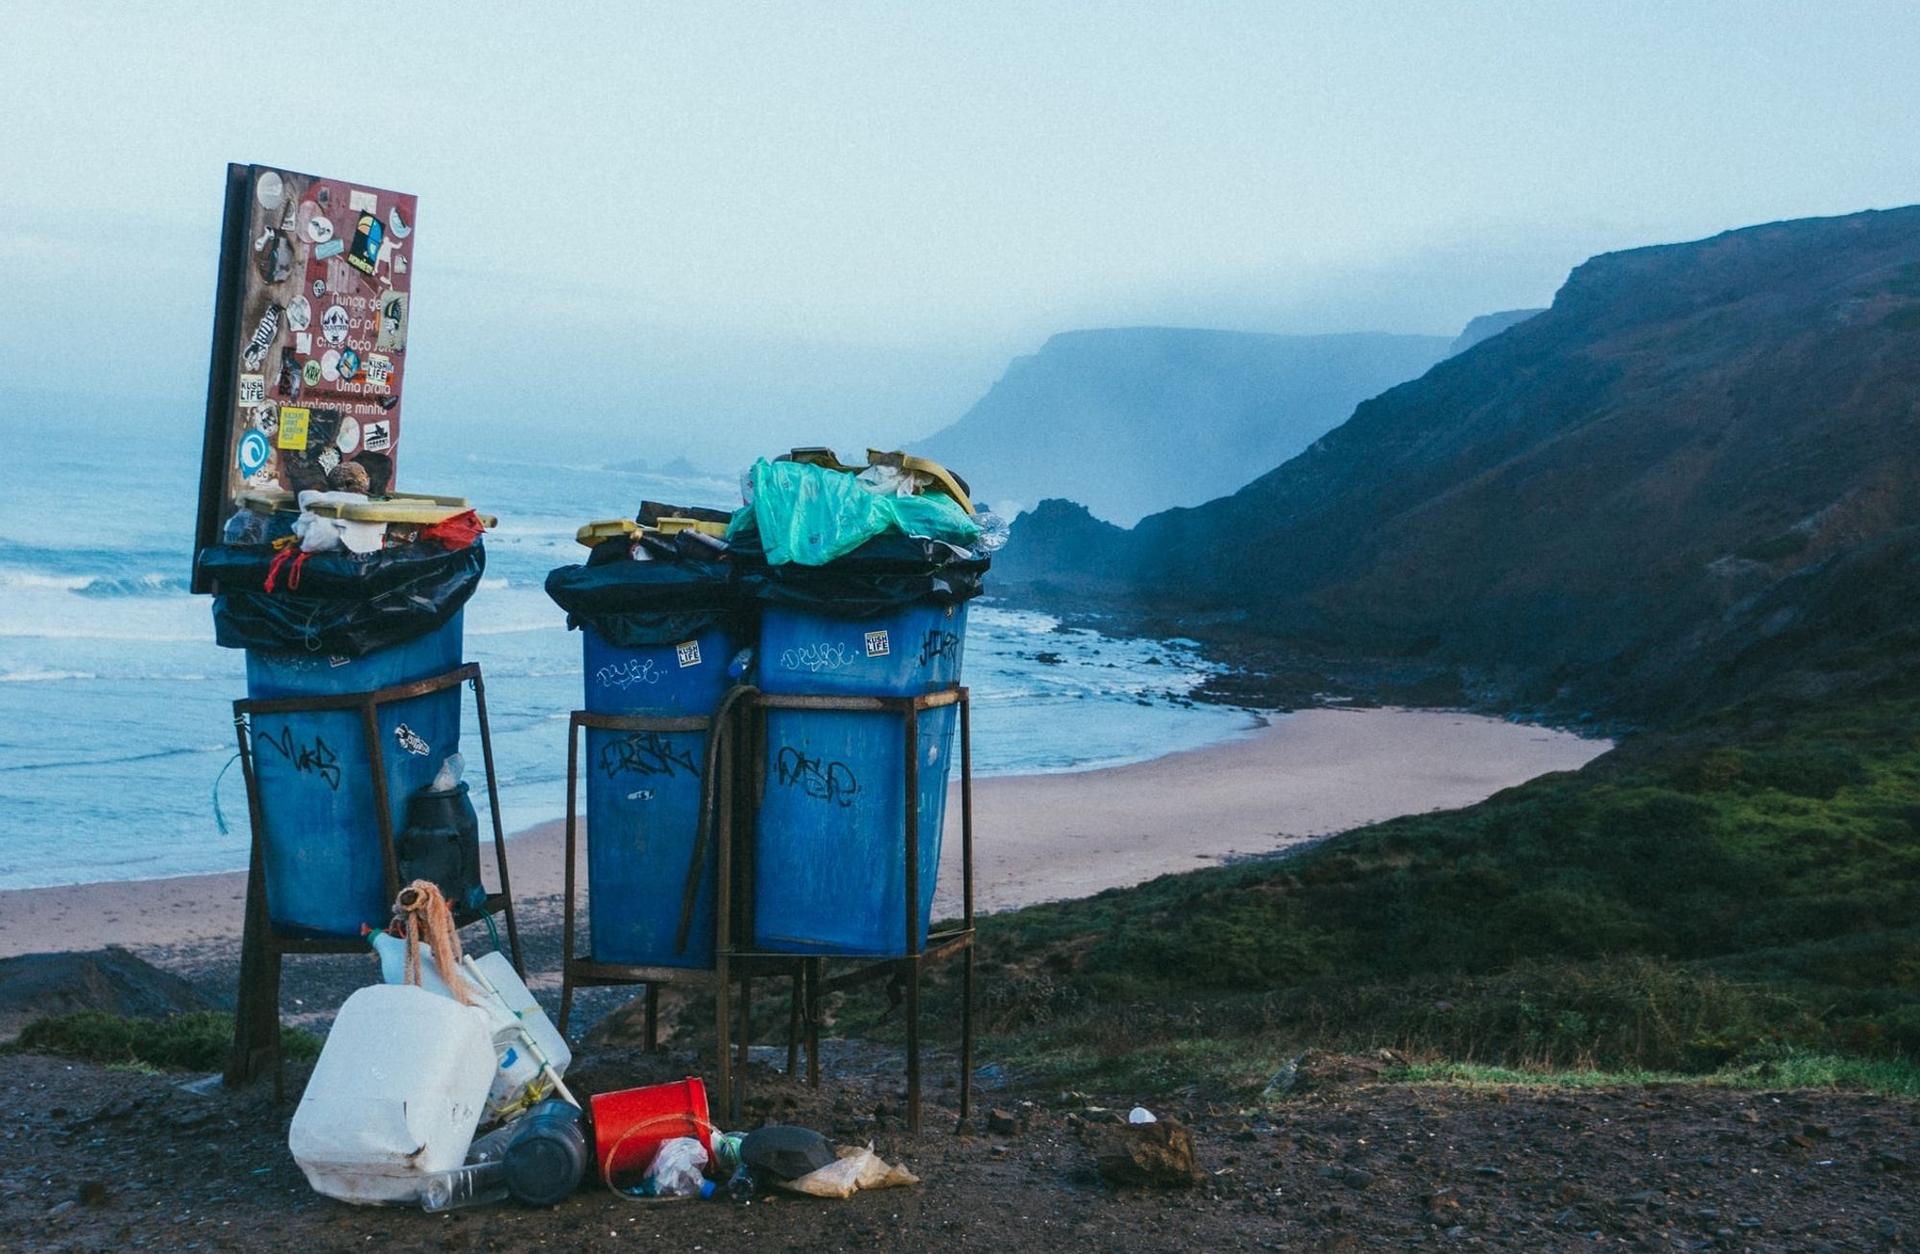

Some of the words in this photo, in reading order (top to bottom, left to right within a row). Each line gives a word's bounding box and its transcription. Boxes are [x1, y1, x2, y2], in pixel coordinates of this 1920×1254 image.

[368, 361, 387, 371] KUSH
[367, 369, 387, 380] LIFE
[241, 381, 264, 389] KUSH
[336, 379, 361, 393] Uma
[241, 389, 265, 400] LIFE
[867, 635, 887, 644] KUSH
[868, 641, 888, 651] LIFE
[680, 651, 699, 662] LIFE
